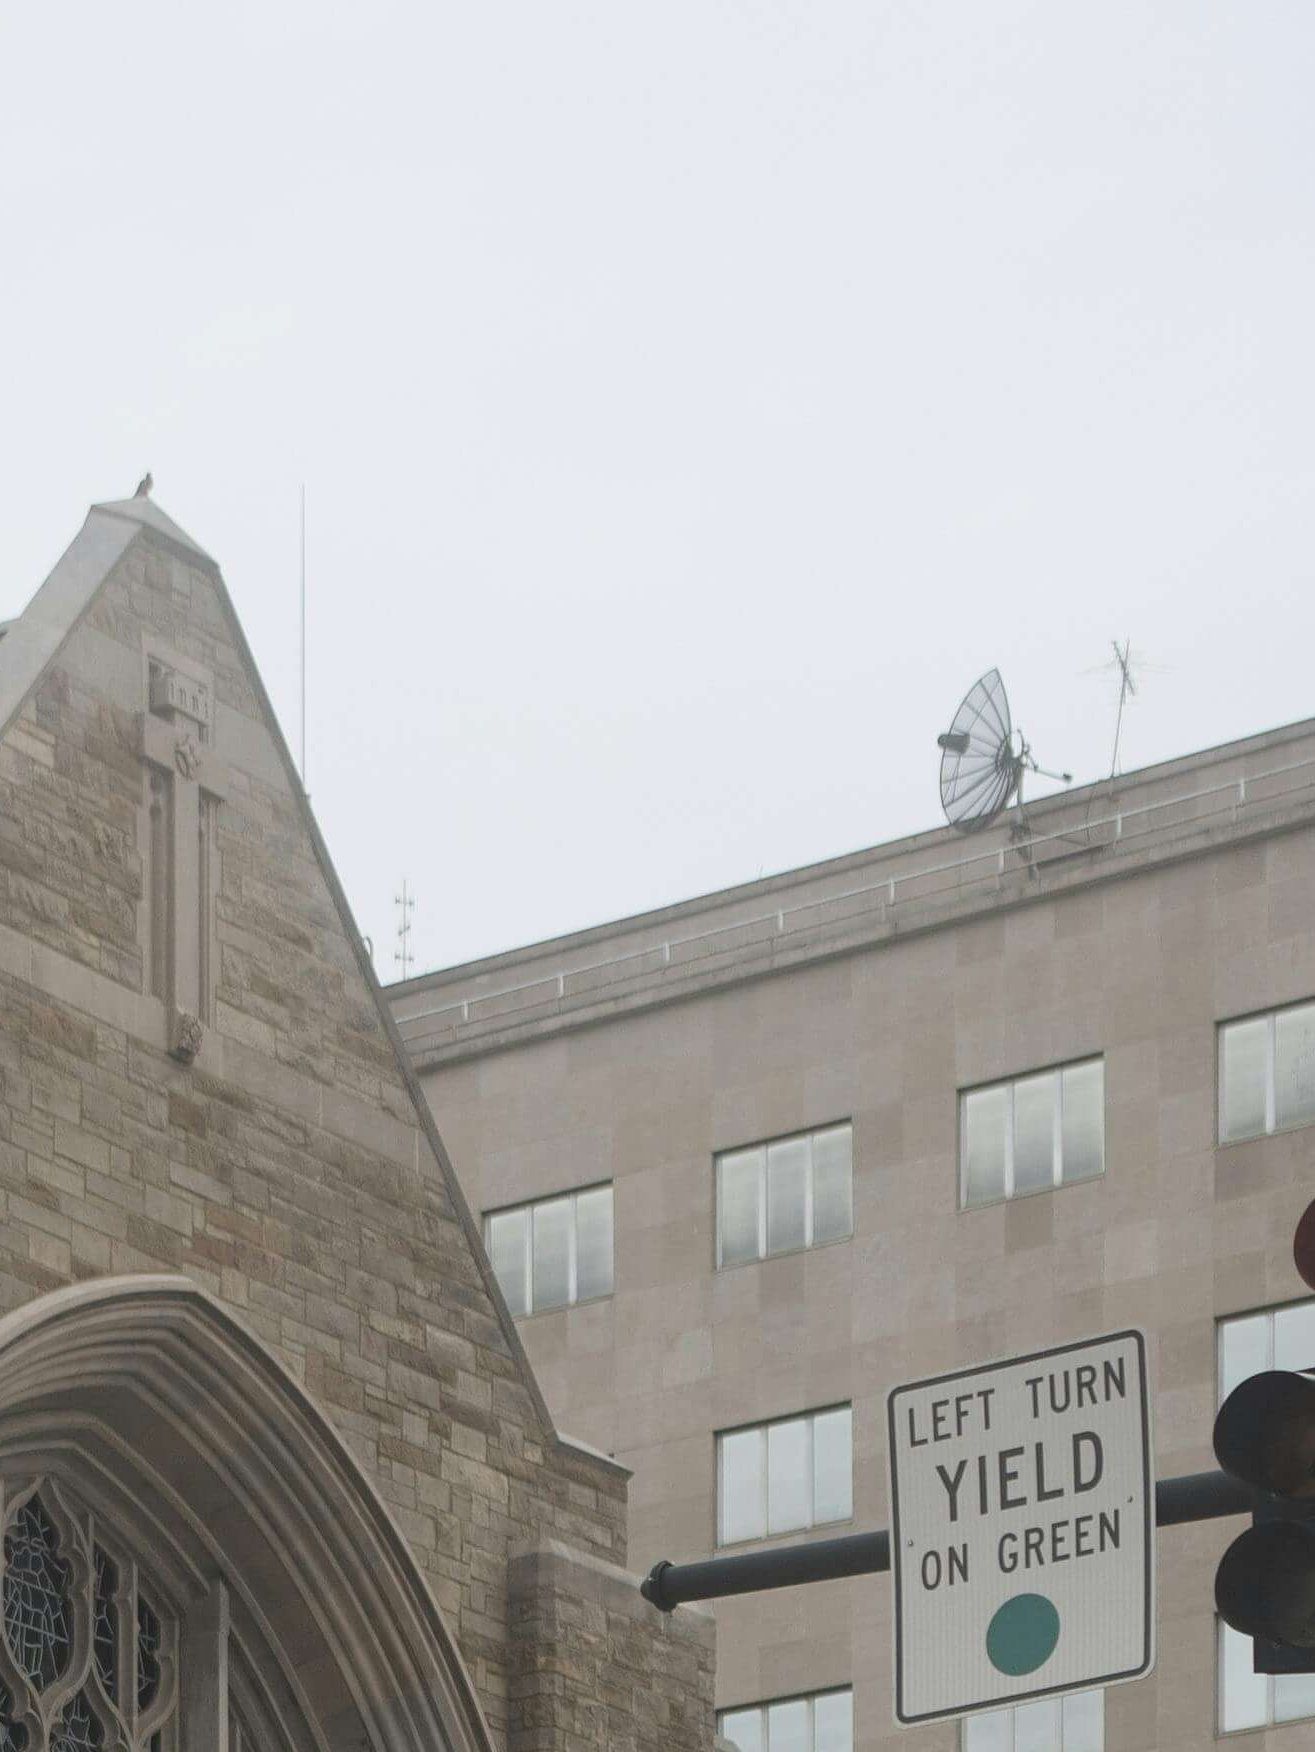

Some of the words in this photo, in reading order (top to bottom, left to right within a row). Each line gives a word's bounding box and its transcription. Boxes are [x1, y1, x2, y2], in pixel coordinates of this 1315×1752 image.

[908, 1388, 995, 1448] LEFT
[1025, 1357, 1126, 1419] TURN
[935, 1431, 1104, 1522] YIELD
[921, 1543, 969, 1591] ON
[998, 1509, 1120, 1574] GREEN
